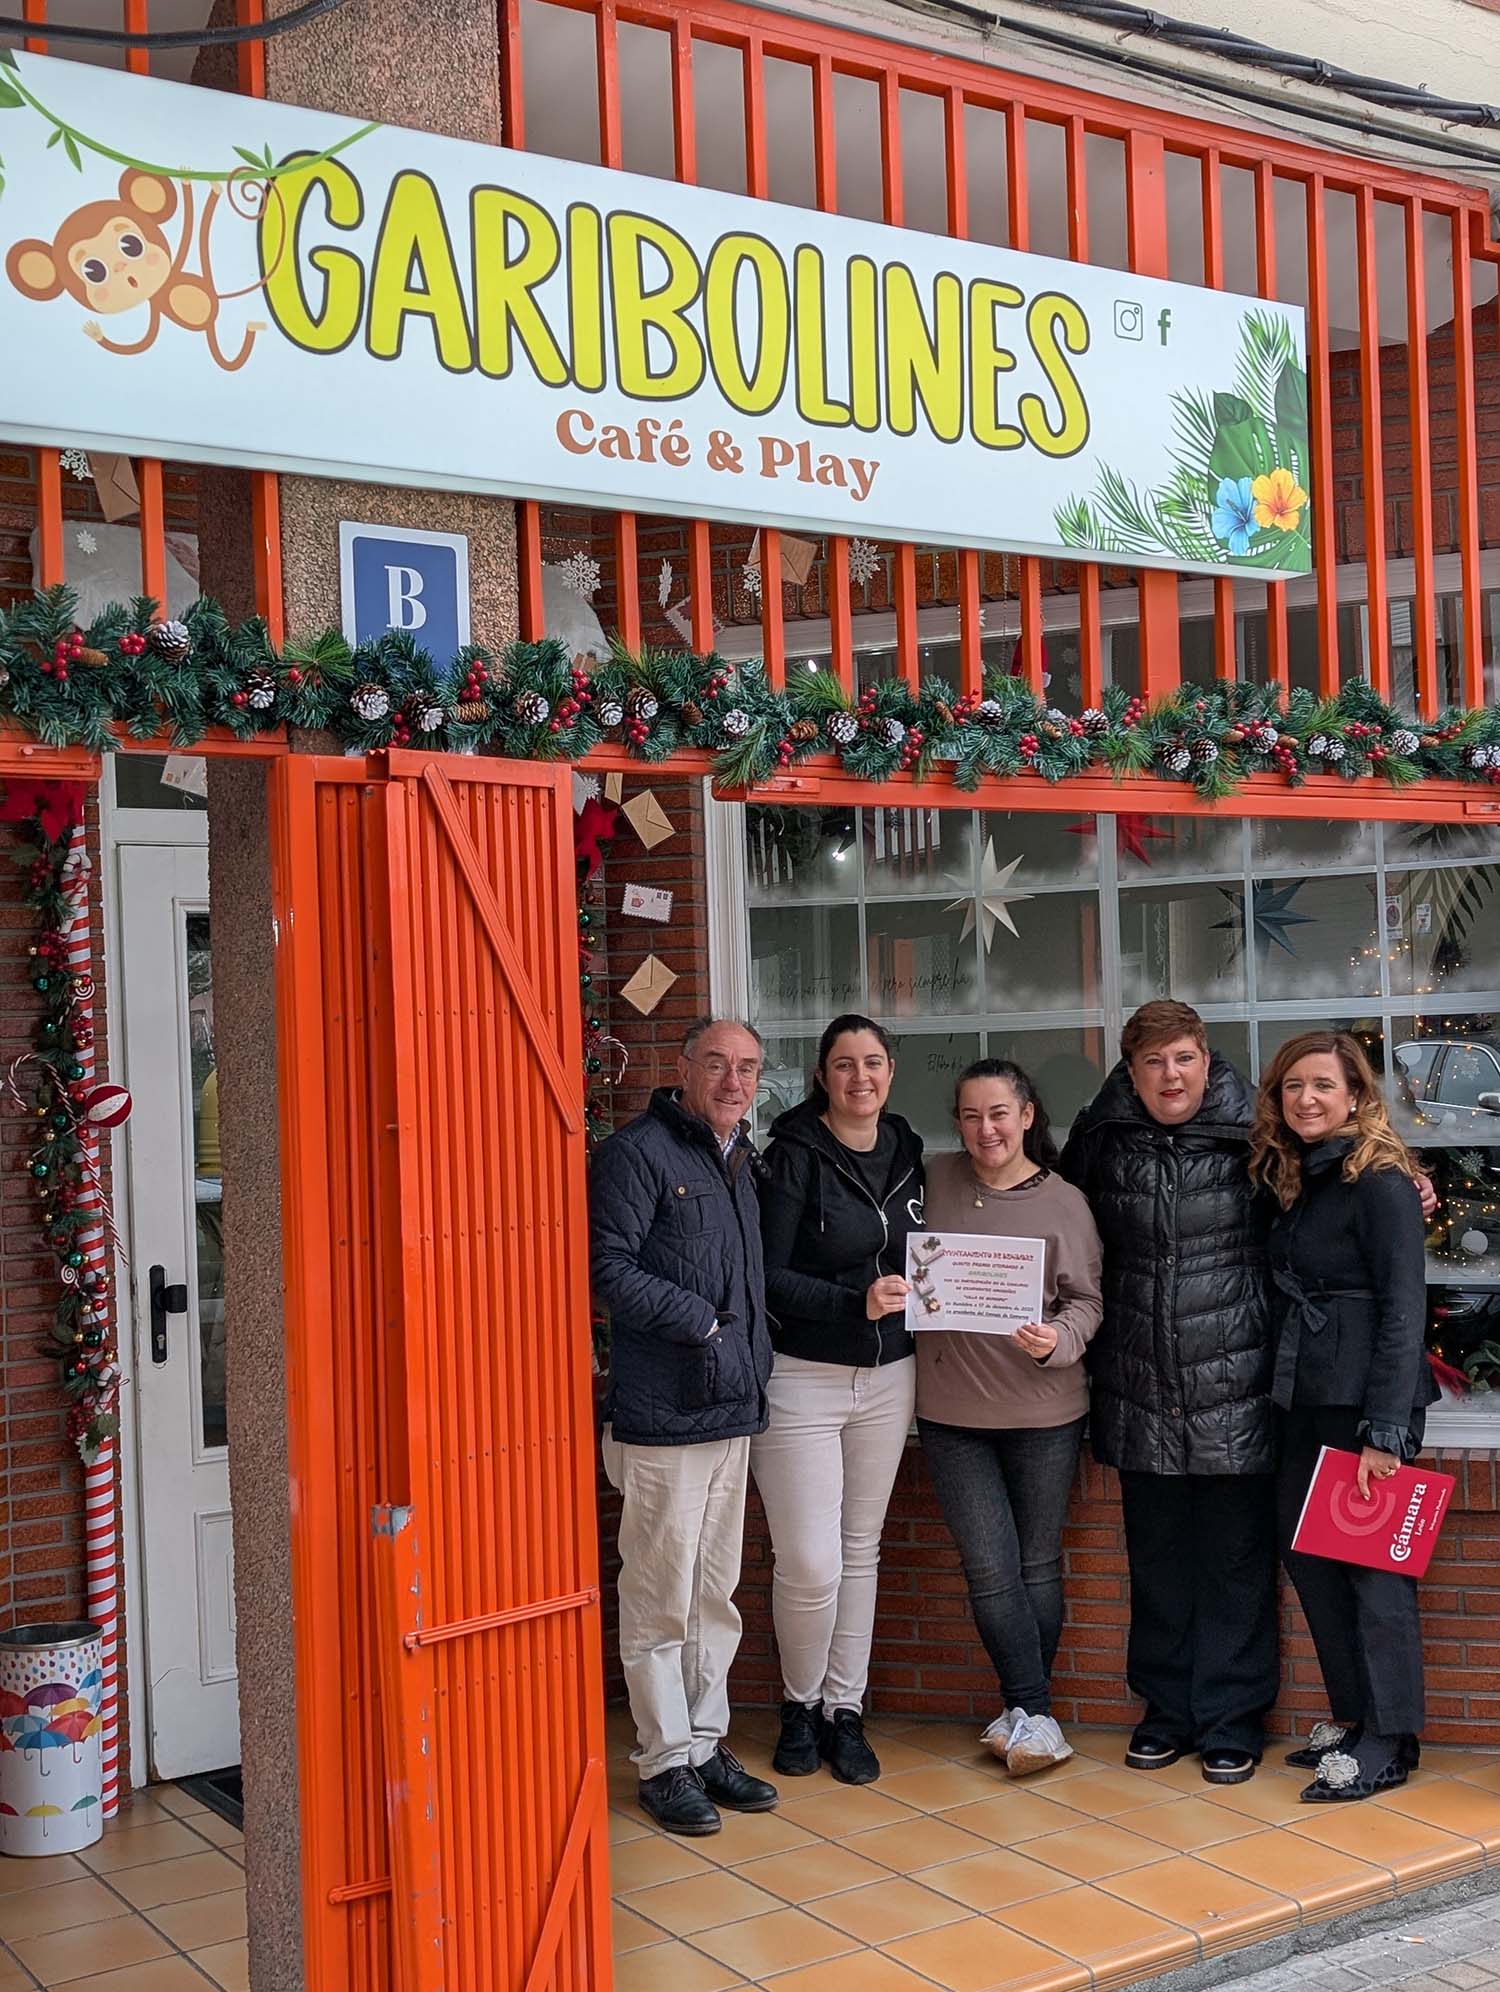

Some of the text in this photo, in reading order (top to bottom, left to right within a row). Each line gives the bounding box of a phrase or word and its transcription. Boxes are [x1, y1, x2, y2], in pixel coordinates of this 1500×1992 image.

[257, 150, 1091, 458] GARIBOLINES
[556, 409, 881, 501] Café & Play
[384, 565, 427, 629] B
[1390, 1483, 1427, 1561] Cámara
